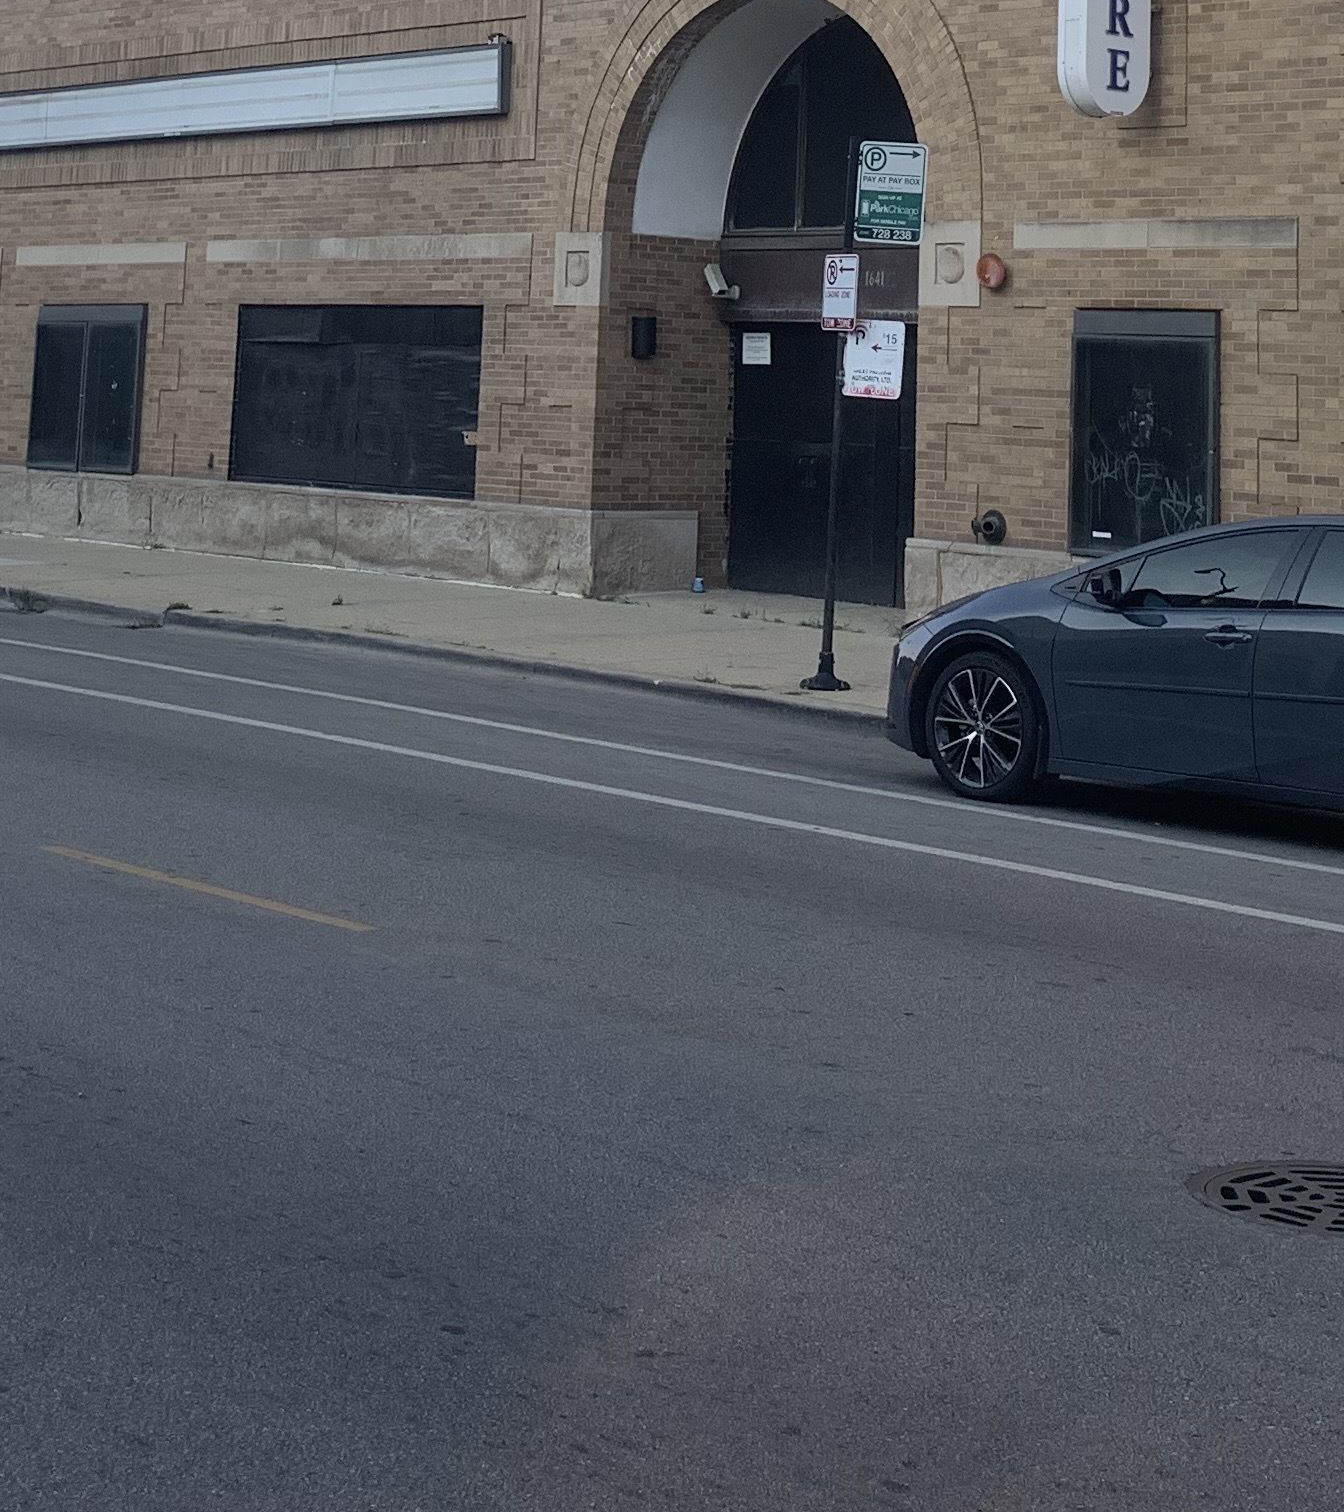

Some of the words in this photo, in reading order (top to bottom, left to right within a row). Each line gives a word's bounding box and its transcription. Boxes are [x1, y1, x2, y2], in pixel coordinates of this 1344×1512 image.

[863, 175, 876, 183] PAY
[904, 178, 921, 186] BOX
[872, 228, 891, 239] 728
[893, 230, 912, 241] 238
[864, 270, 885, 286] 1641
